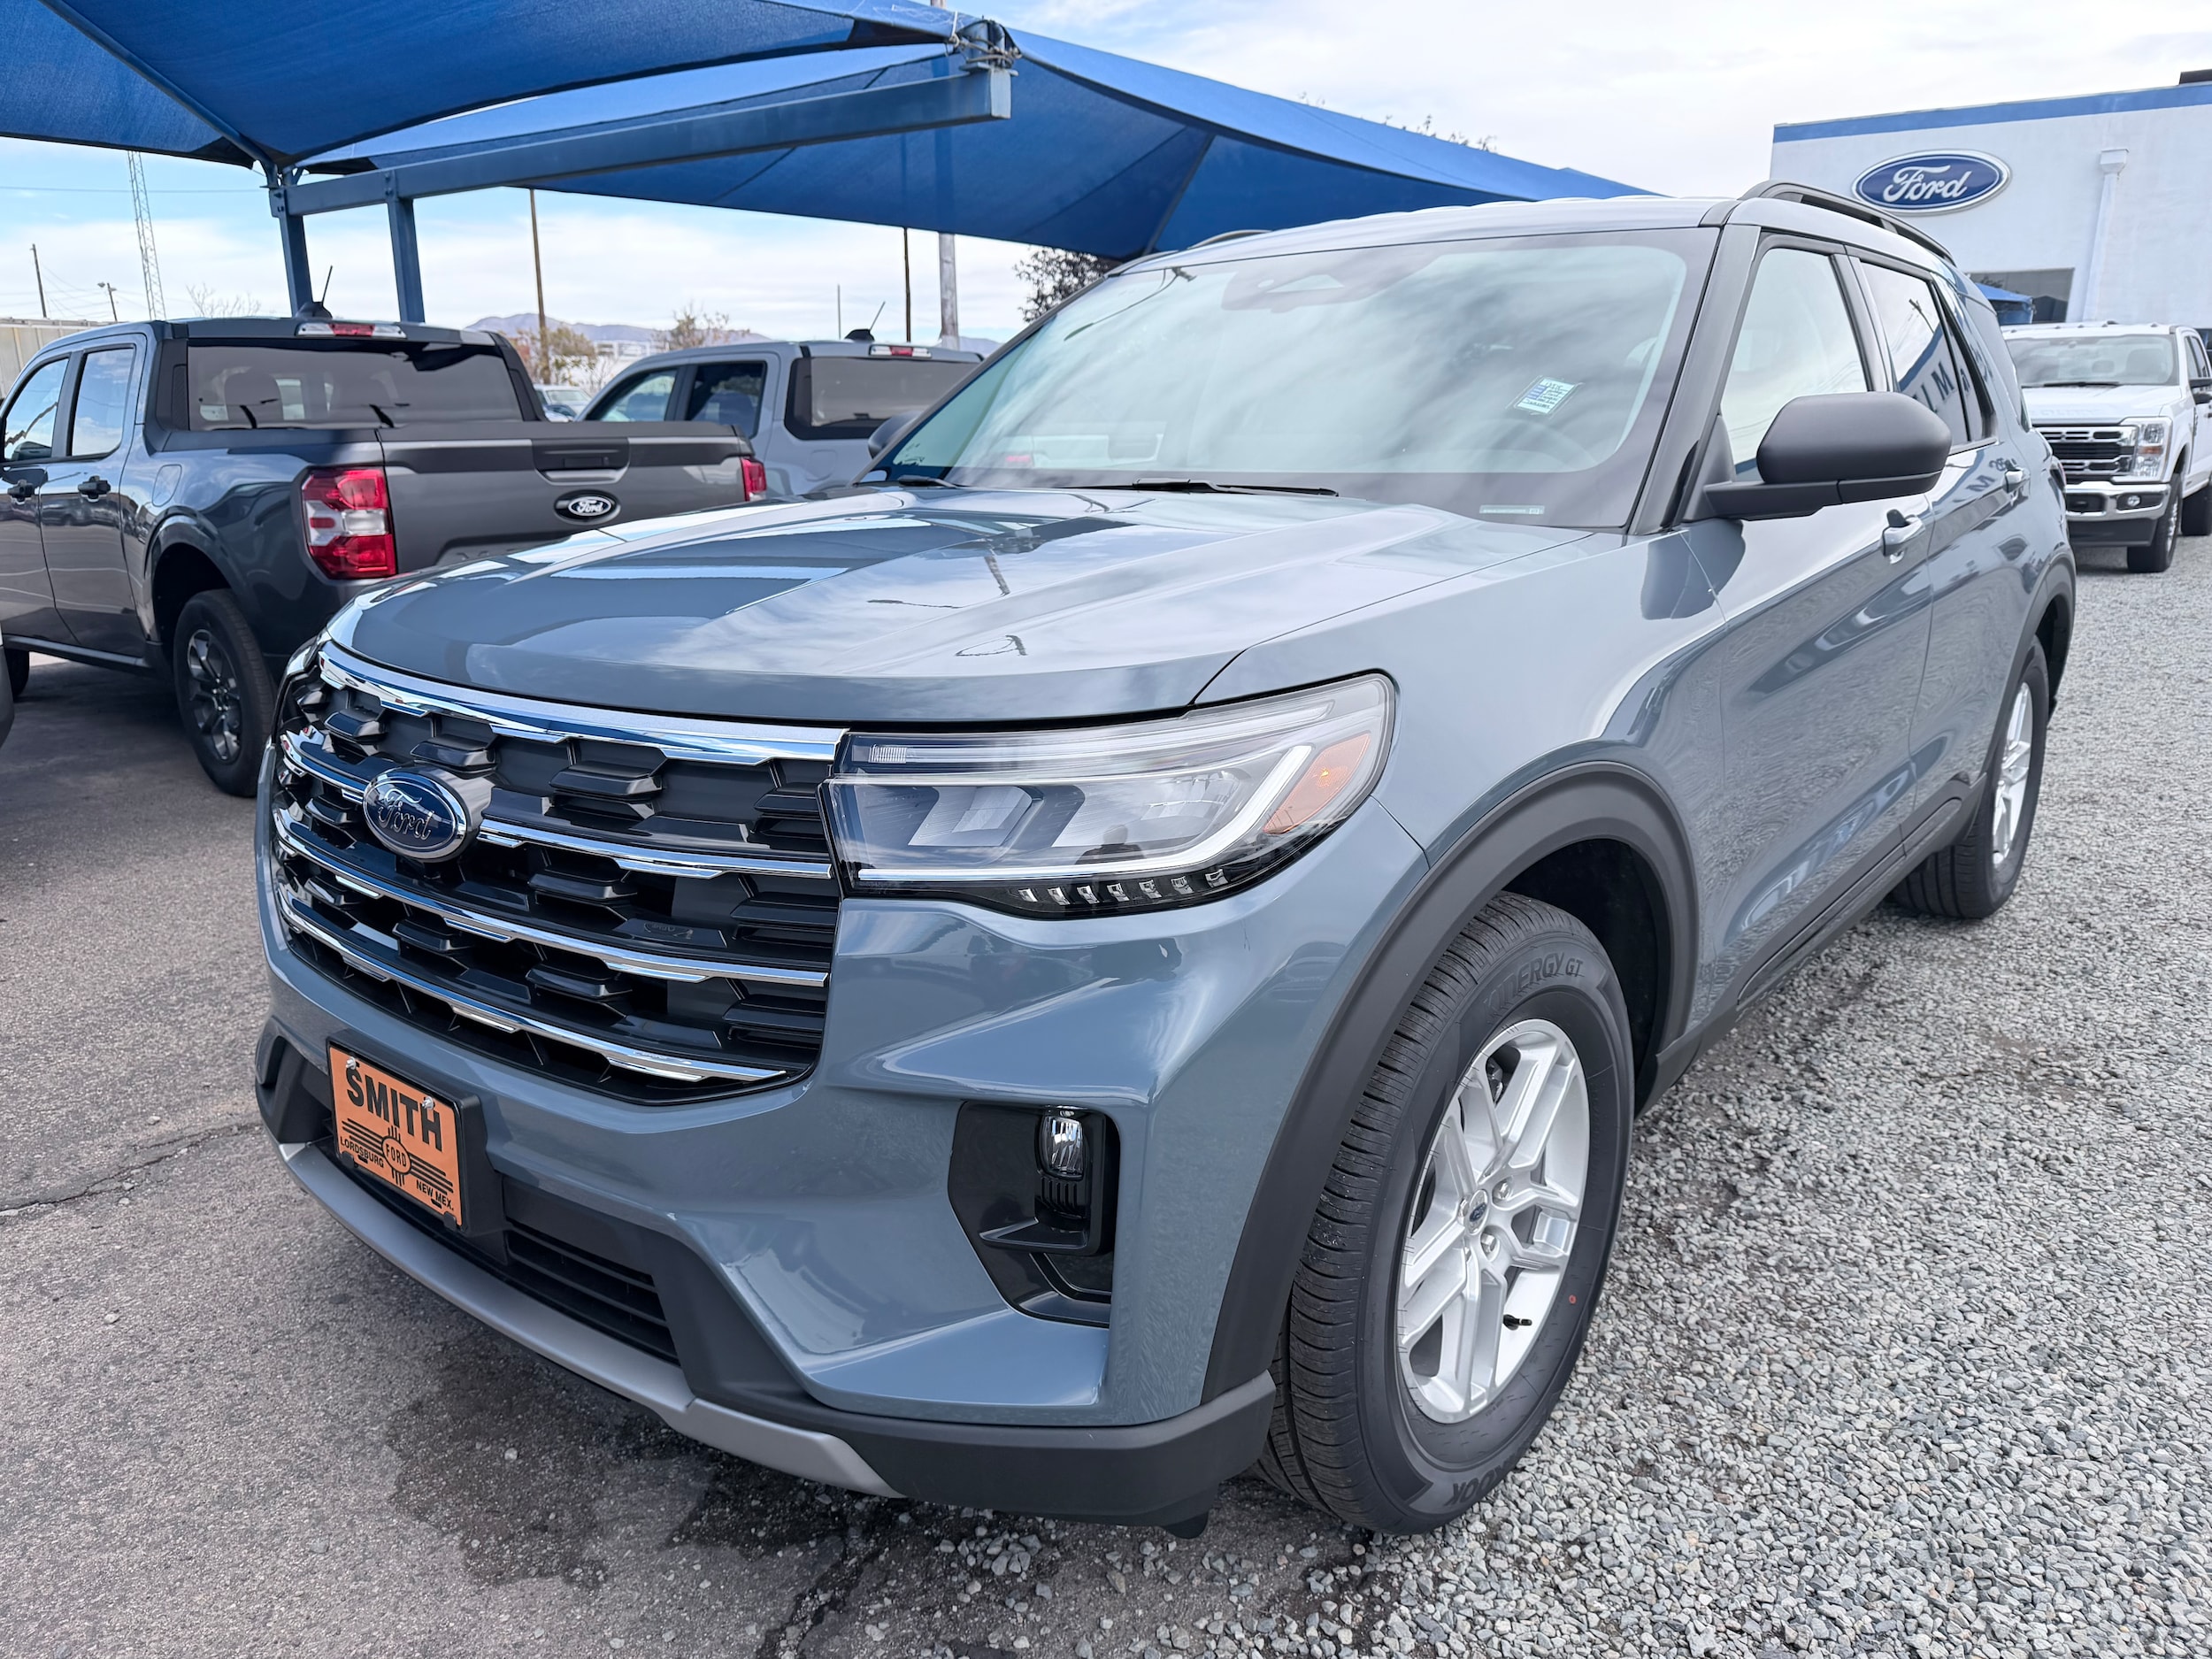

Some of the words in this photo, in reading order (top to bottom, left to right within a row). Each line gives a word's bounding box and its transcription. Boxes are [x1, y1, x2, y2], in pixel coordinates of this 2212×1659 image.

[1882, 165, 1972, 203] Ford
[577, 499, 603, 513] Ford
[378, 788, 432, 841] Ford
[1565, 957, 1584, 978] GT
[345, 1062, 442, 1152] SMITH
[340, 1136, 384, 1168] LORDSBURG
[385, 1143, 407, 1168] FORD
[416, 1179, 434, 1198] NEW
[434, 1193, 454, 1211] MEX.
